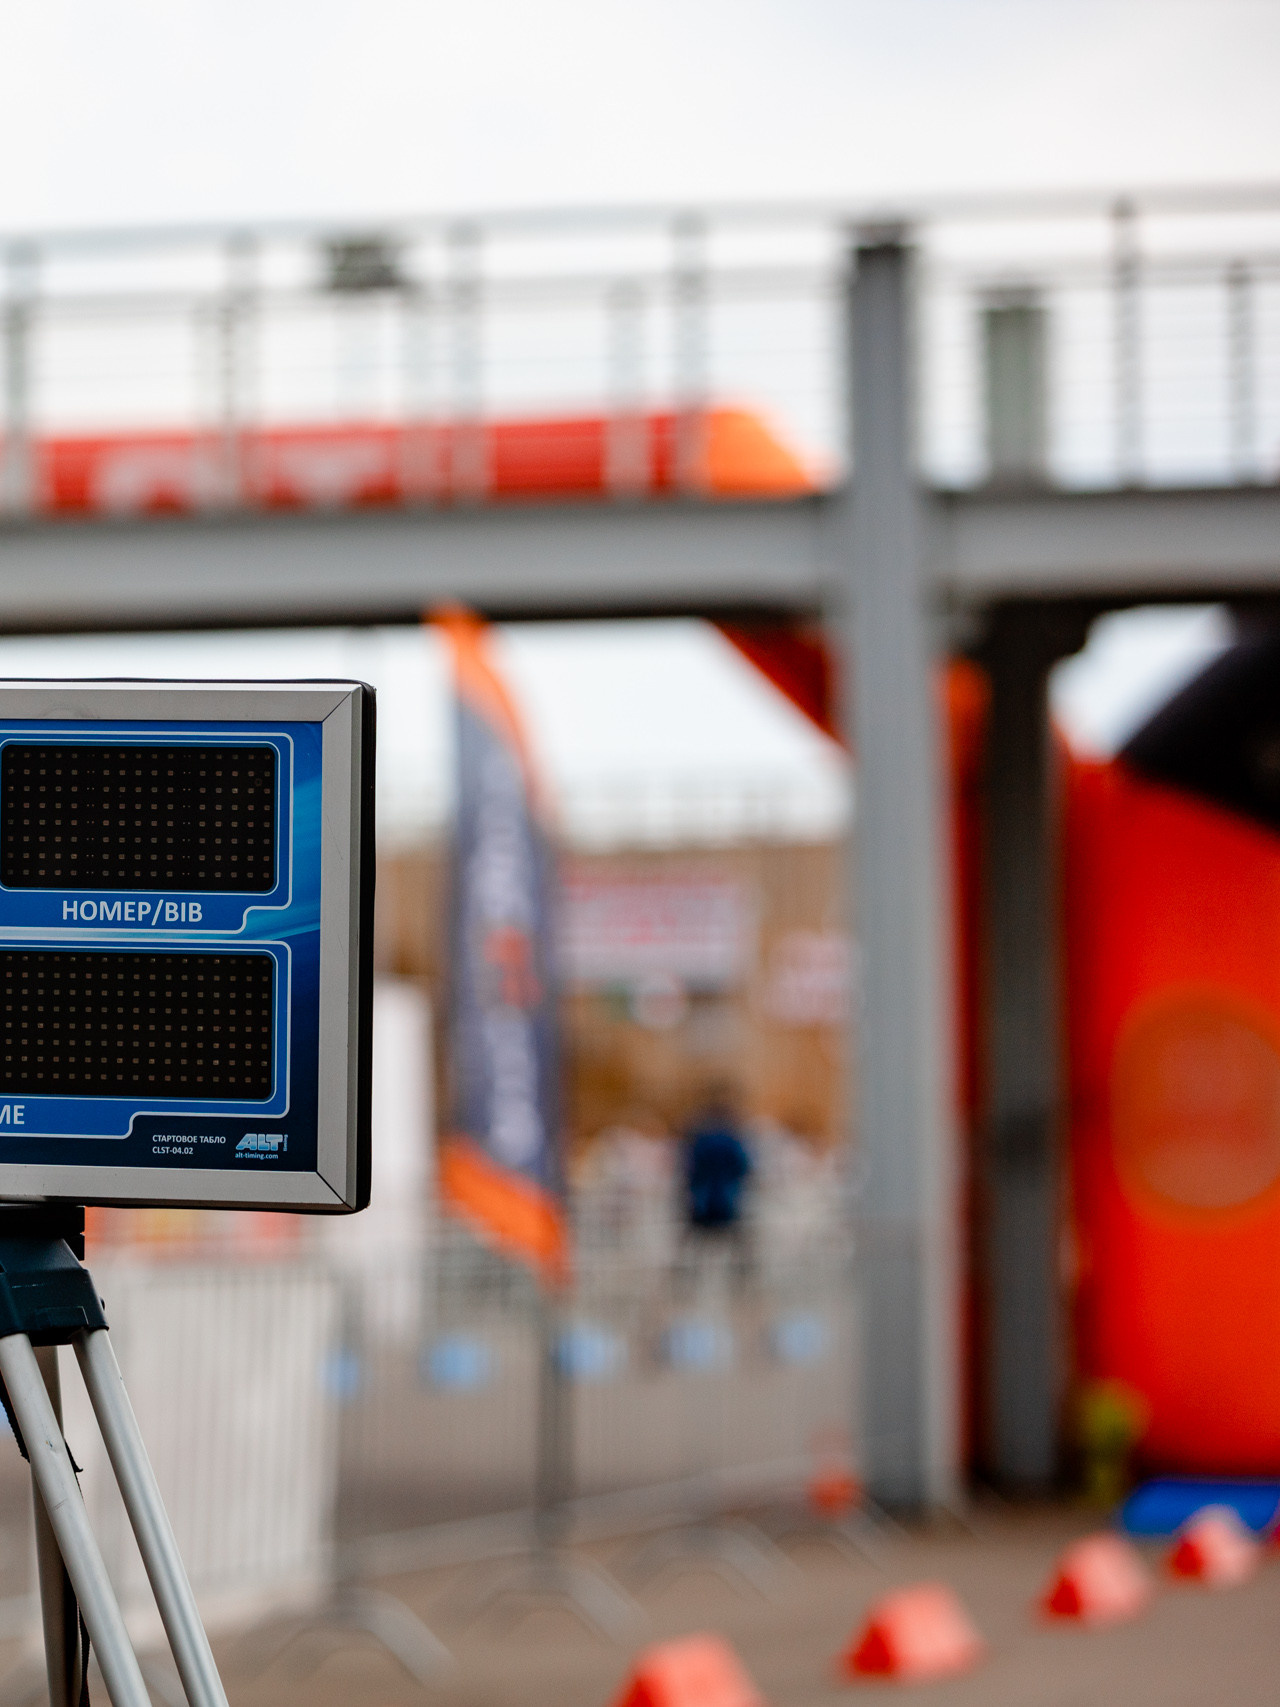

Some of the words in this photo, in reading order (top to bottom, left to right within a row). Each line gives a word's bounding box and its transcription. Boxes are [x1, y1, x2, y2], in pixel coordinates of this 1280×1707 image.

[62, 899, 203, 926] НОМЕР/BIB
[152, 1134, 198, 1144] СТАРТОВОЕ
[199, 1135, 227, 1144] ТАБЛО
[235, 1133, 283, 1151] ALT
[152, 1146, 194, 1155] CLST-04.02
[234, 1152, 279, 1160] alt-timing.com
